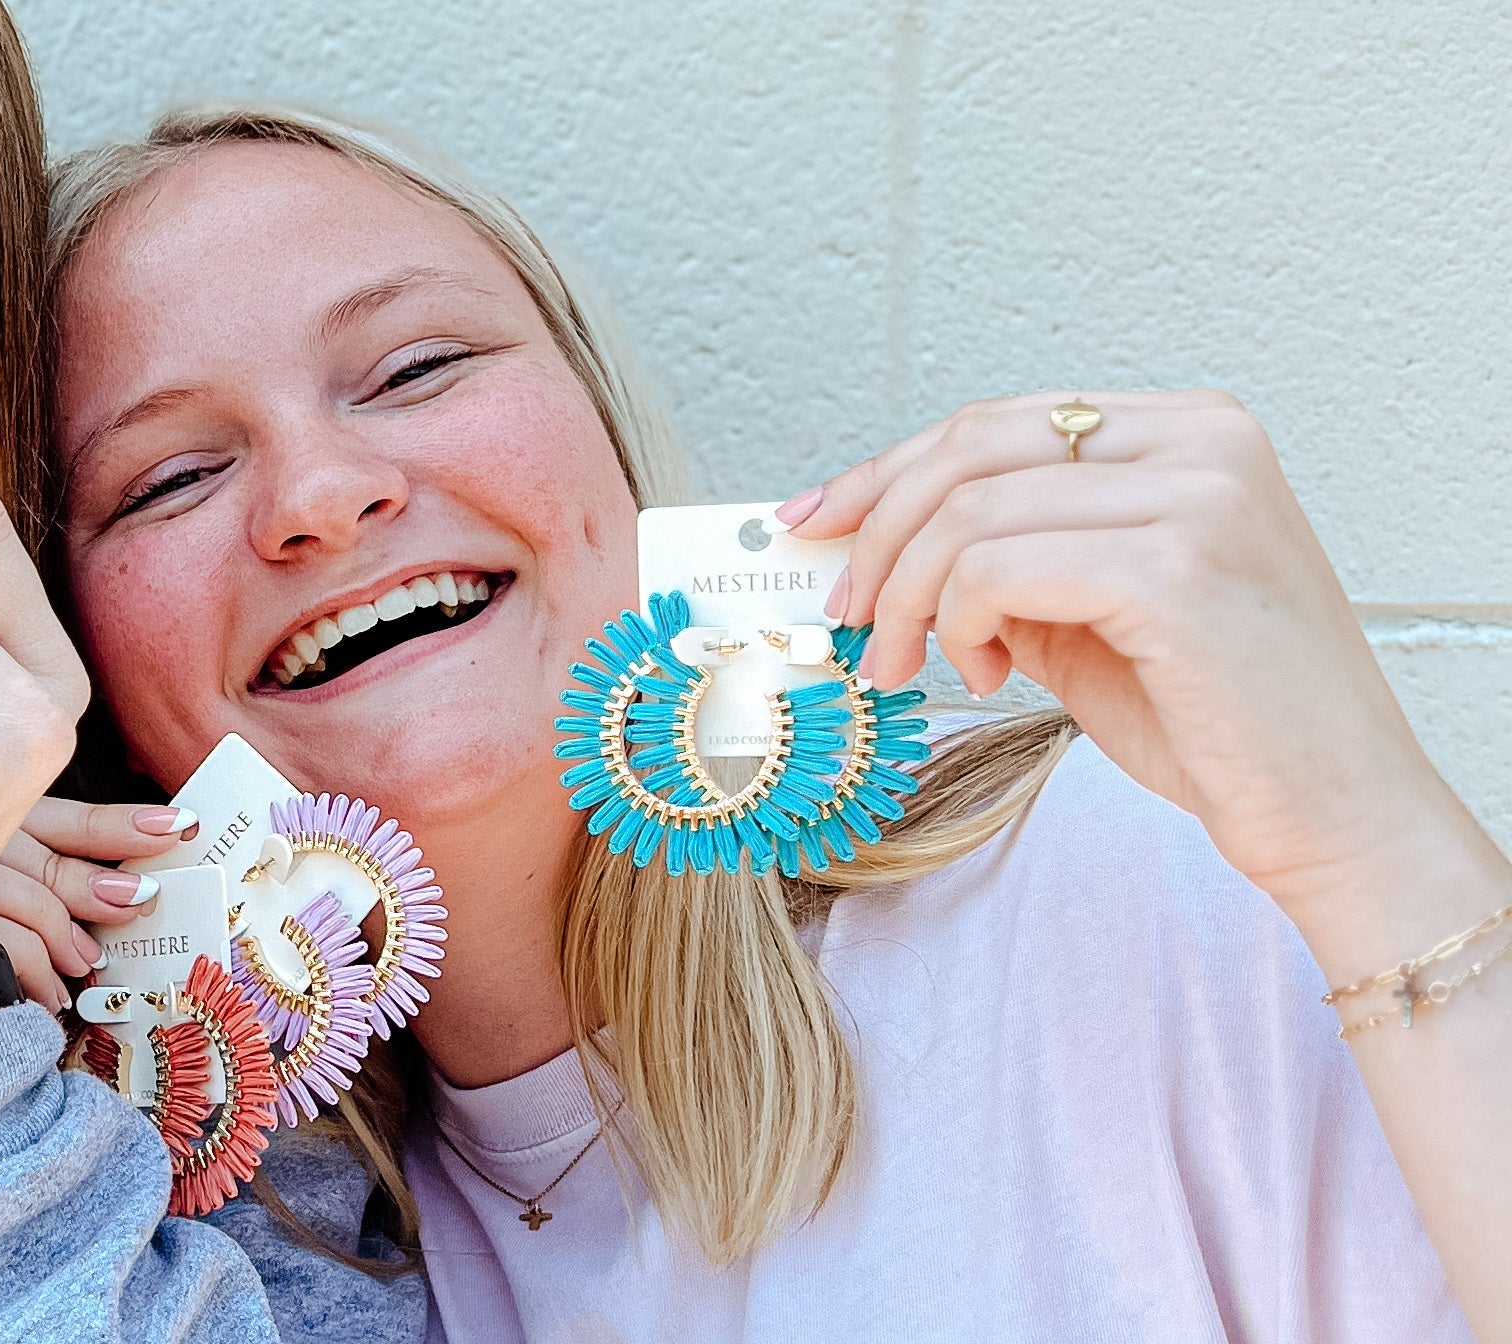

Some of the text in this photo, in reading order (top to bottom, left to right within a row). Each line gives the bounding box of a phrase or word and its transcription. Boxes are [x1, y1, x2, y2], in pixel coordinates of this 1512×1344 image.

[692, 570, 817, 594] MESTIERE
[741, 735, 772, 745] COM
[198, 810, 254, 866] TIERE
[102, 935, 190, 961] MESTIERE
